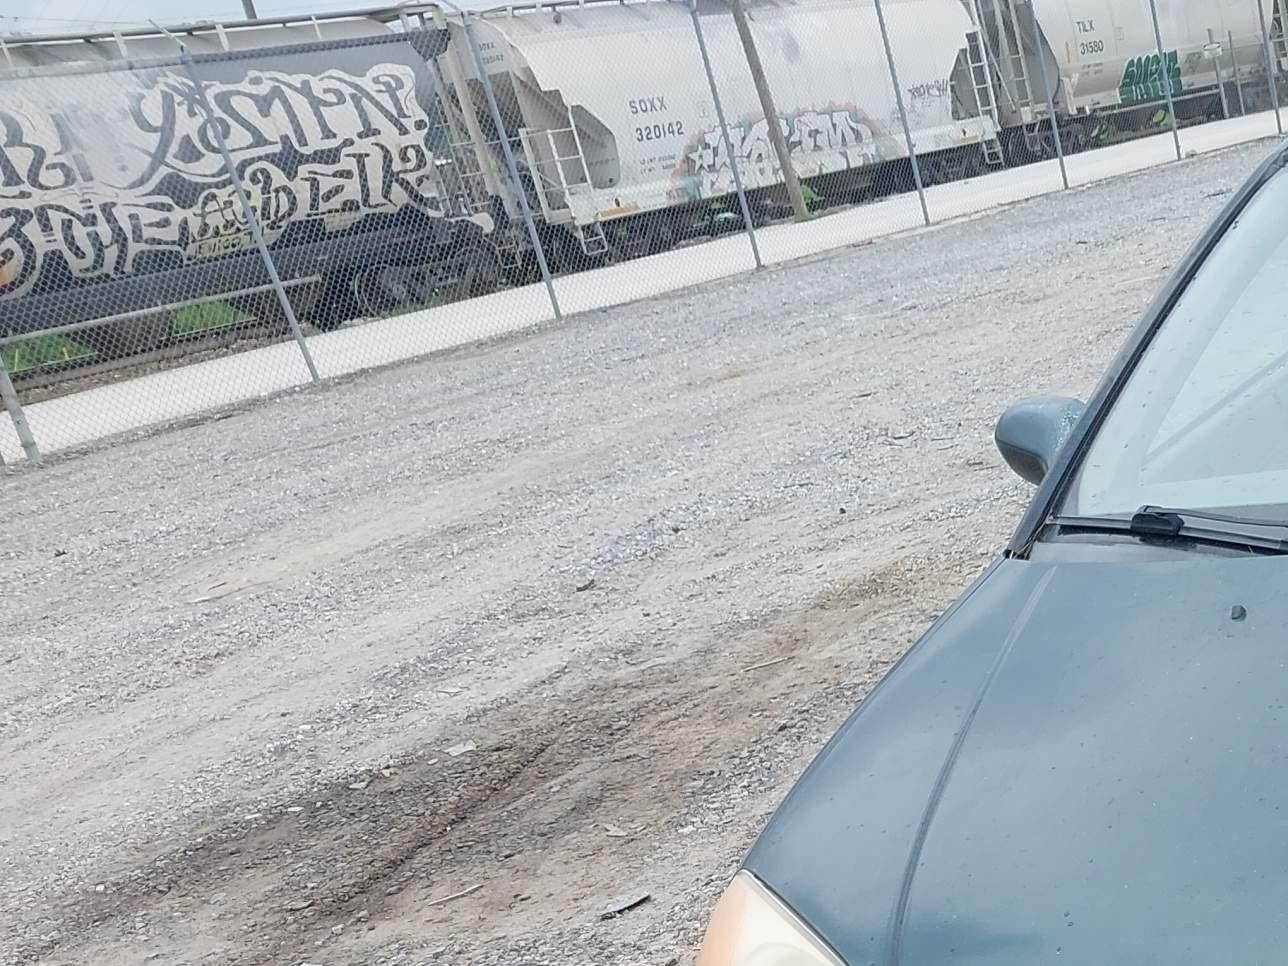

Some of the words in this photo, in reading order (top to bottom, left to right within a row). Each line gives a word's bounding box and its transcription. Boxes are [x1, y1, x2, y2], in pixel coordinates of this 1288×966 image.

[1076, 20, 1095, 33] TILX
[1080, 40, 1104, 55] 31580
[629, 96, 667, 114] SOXX
[635, 120, 684, 142] 320142
